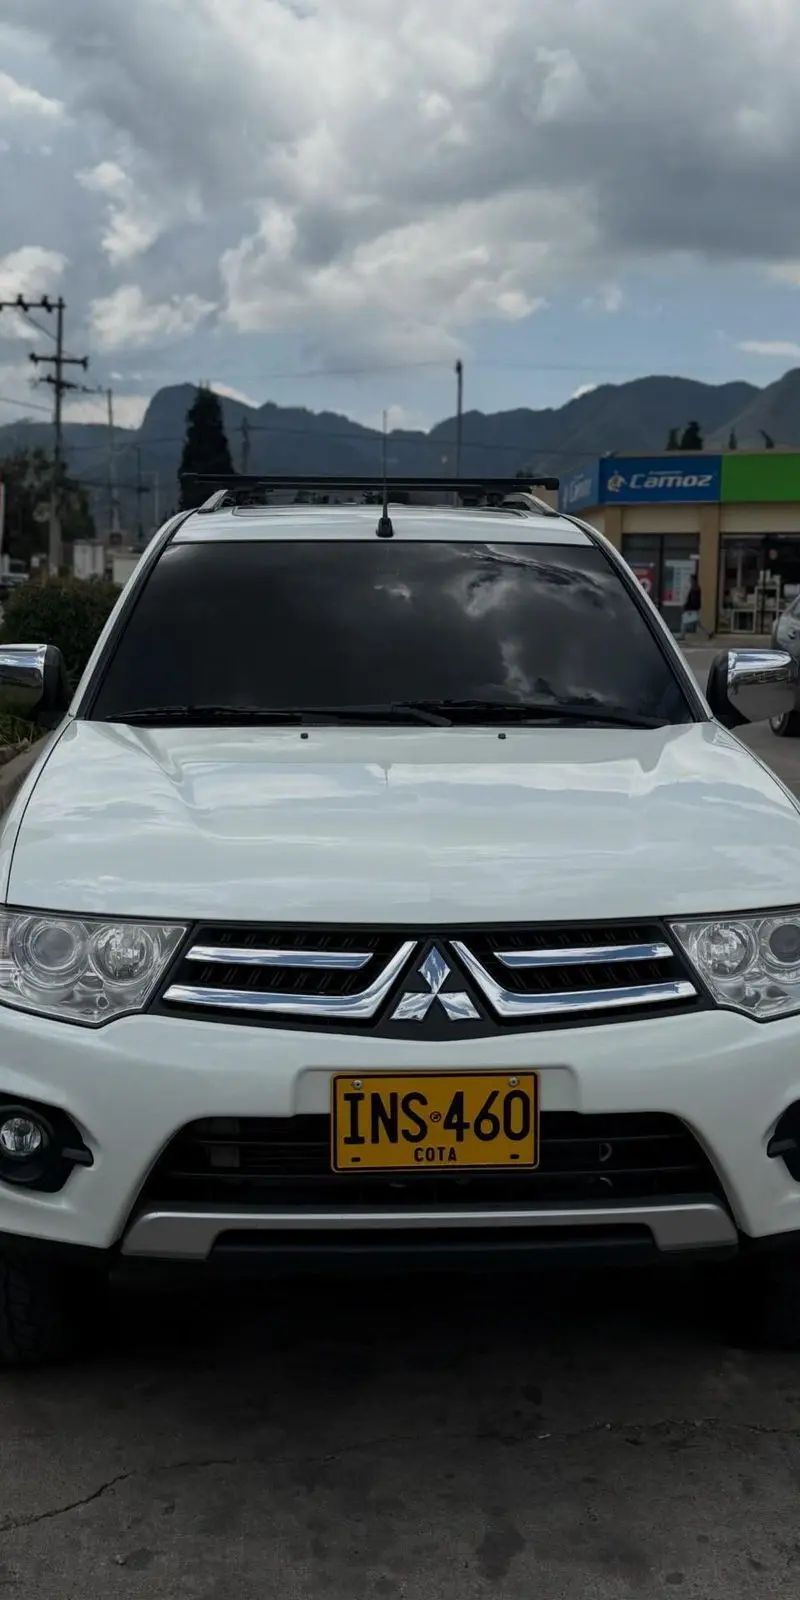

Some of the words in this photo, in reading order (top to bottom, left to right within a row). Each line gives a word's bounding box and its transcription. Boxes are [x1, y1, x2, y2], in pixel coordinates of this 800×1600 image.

[629, 474, 713, 489] Camoz
[344, 1092, 429, 1144] INS
[443, 1090, 530, 1142] 460
[414, 1147, 457, 1162] COTA
